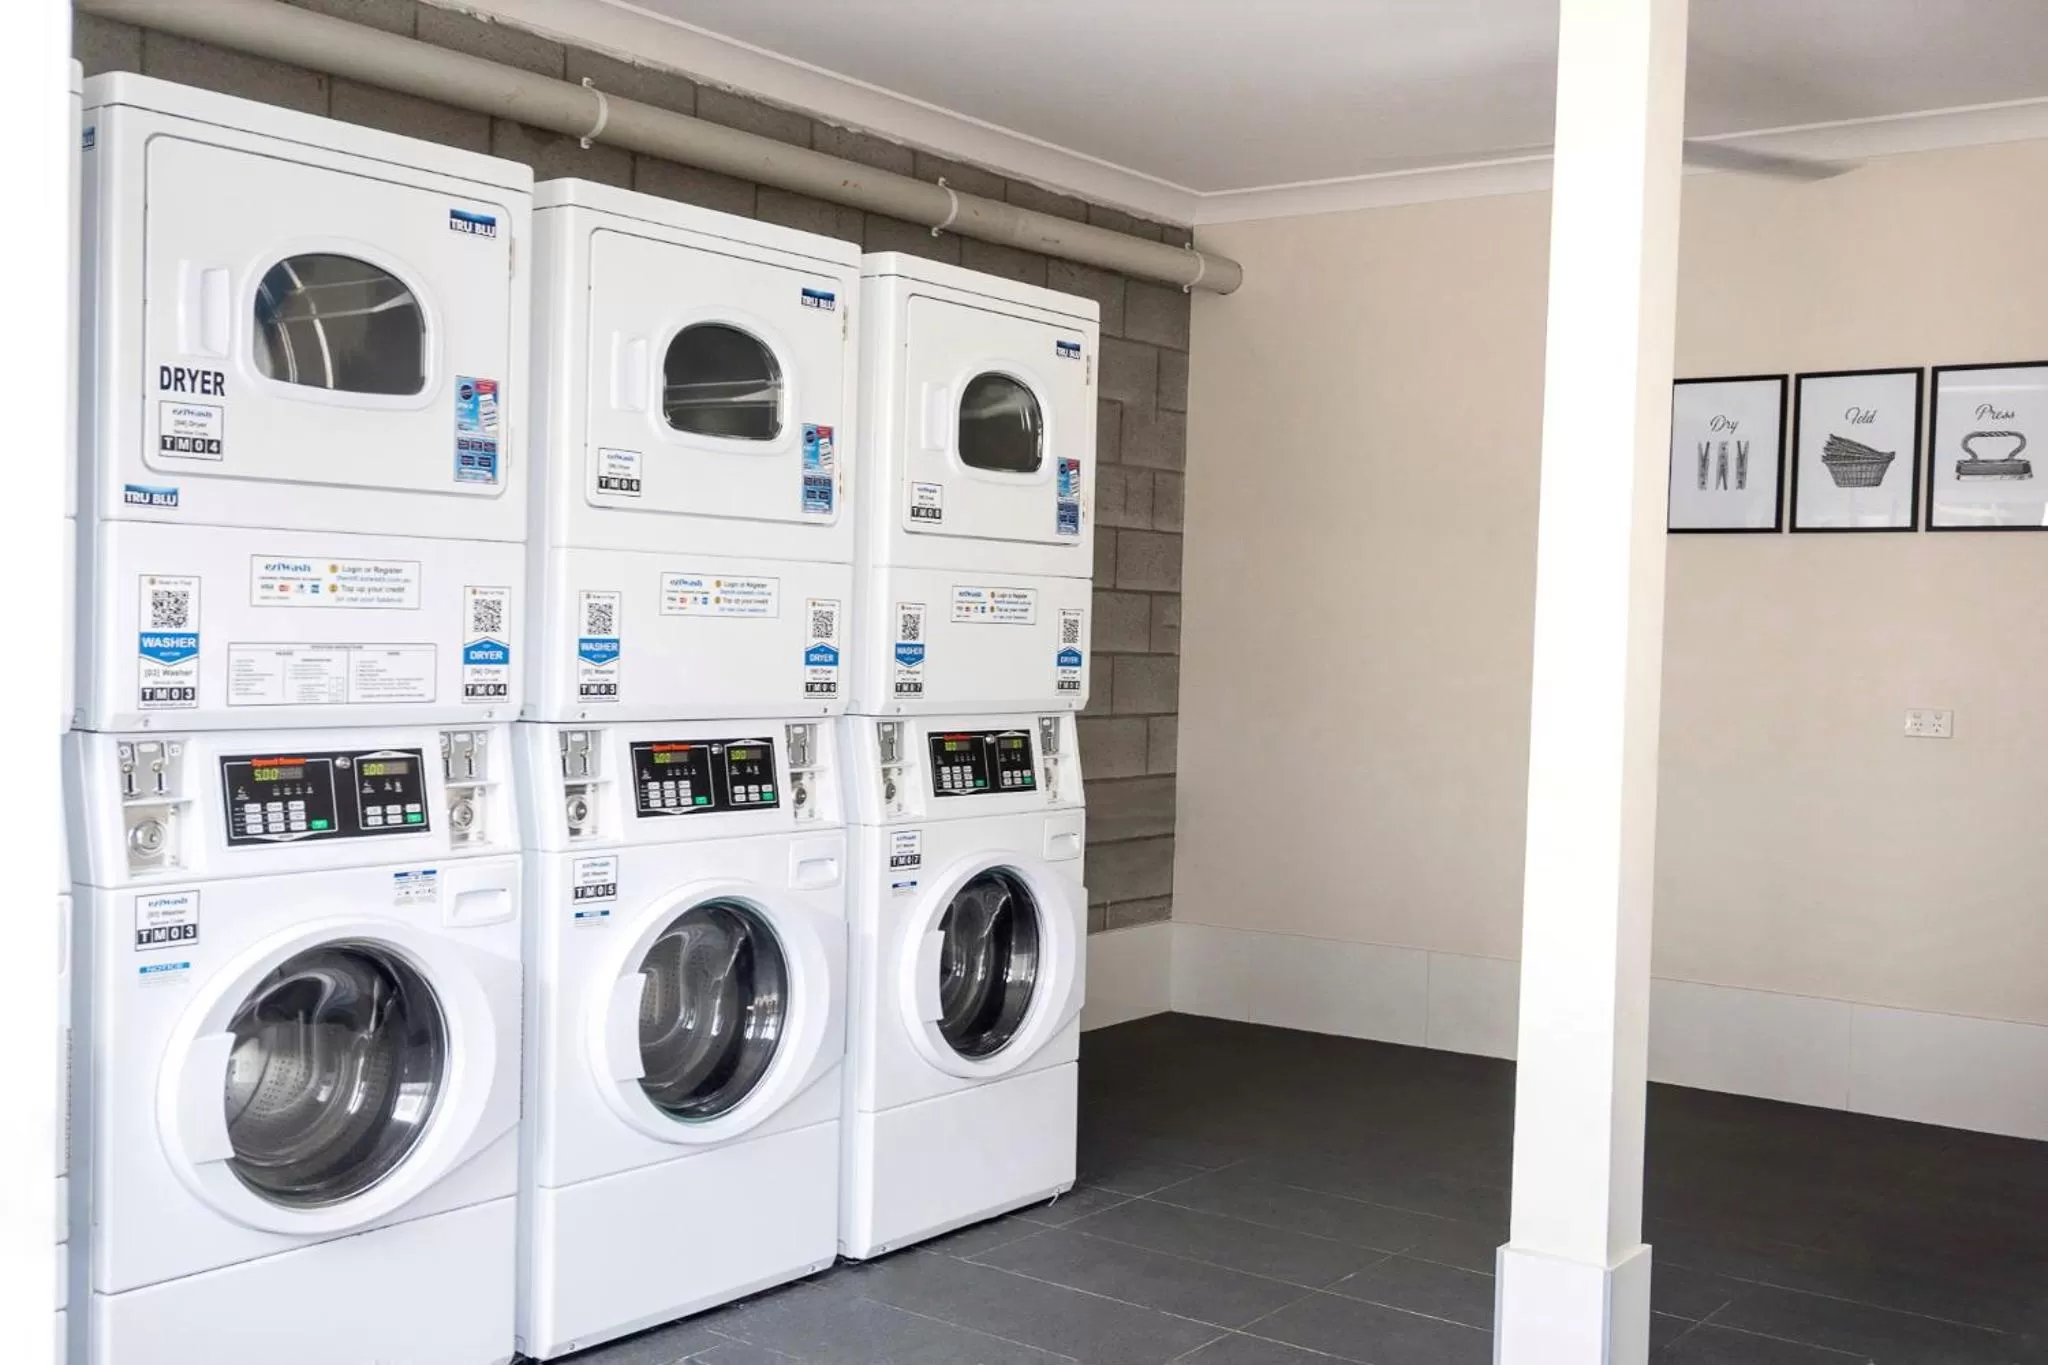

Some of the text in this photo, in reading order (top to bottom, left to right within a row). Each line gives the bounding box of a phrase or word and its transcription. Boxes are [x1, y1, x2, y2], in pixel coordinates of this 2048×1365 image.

[451, 218, 496, 237] TRU BLU
[159, 364, 225, 397] DRYER
[1974, 403, 2015, 421] Press
[1710, 414, 1740, 434] Dry
[162, 436, 220, 454] TM04
[126, 491, 177, 506] TRU BLU
[142, 637, 197, 648] WASHER
[581, 642, 619, 651] WASHER
[470, 650, 503, 660] DRYER
[809, 653, 834, 662] DRYER
[142, 688, 195, 700] TM03
[466, 684, 506, 696] TM04
[575, 883, 616, 898] TM05
[138, 924, 196, 943] TM03
